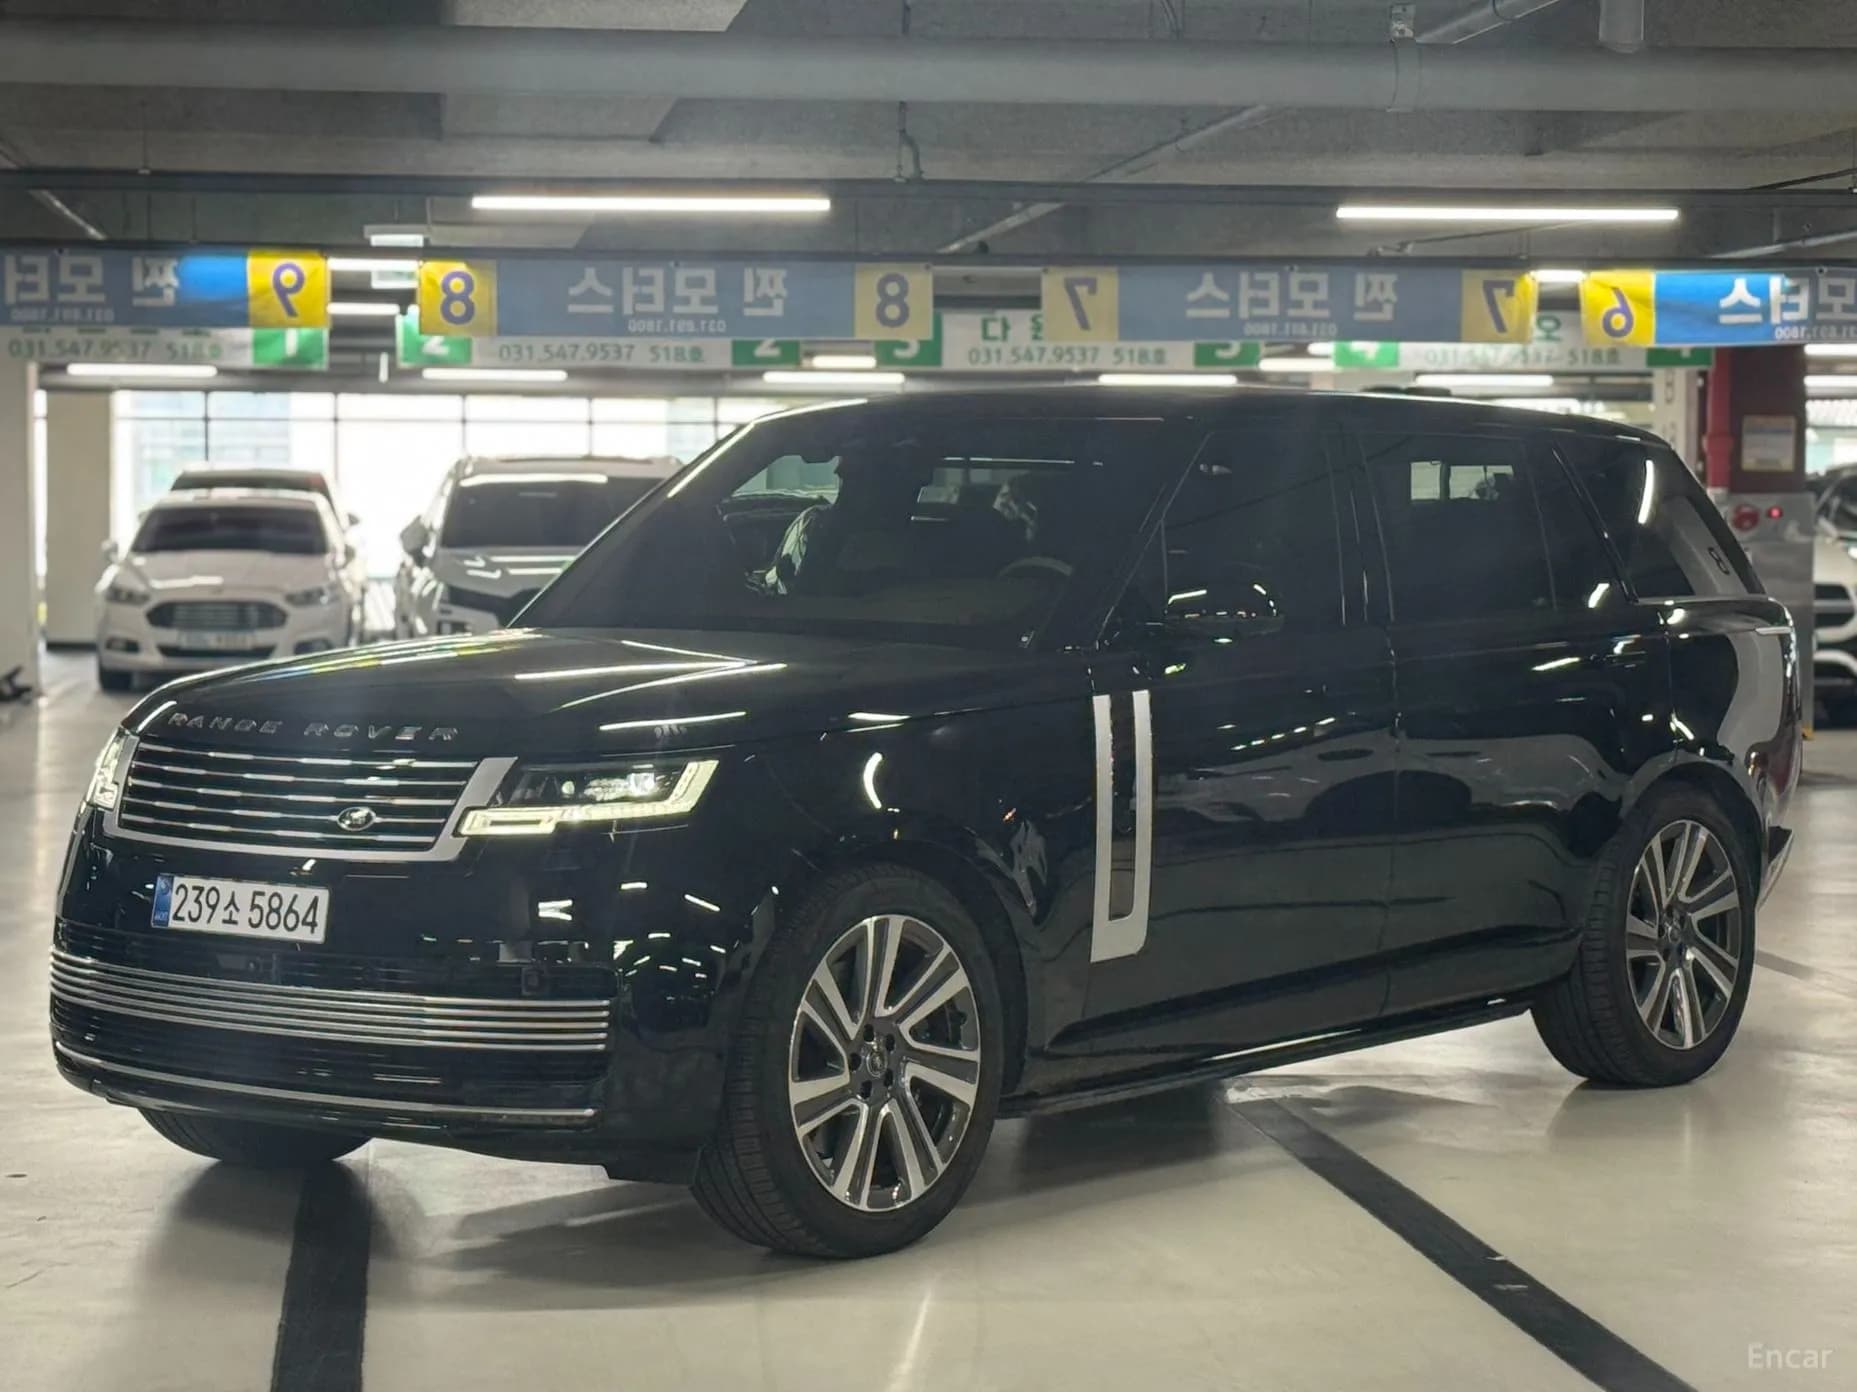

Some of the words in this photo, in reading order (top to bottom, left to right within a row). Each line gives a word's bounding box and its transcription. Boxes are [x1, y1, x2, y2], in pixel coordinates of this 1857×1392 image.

[167, 712, 284, 735] RANGE
[303, 722, 459, 742] ROVER
[171, 882, 241, 925] 239소
[247, 890, 320, 935] 5864
